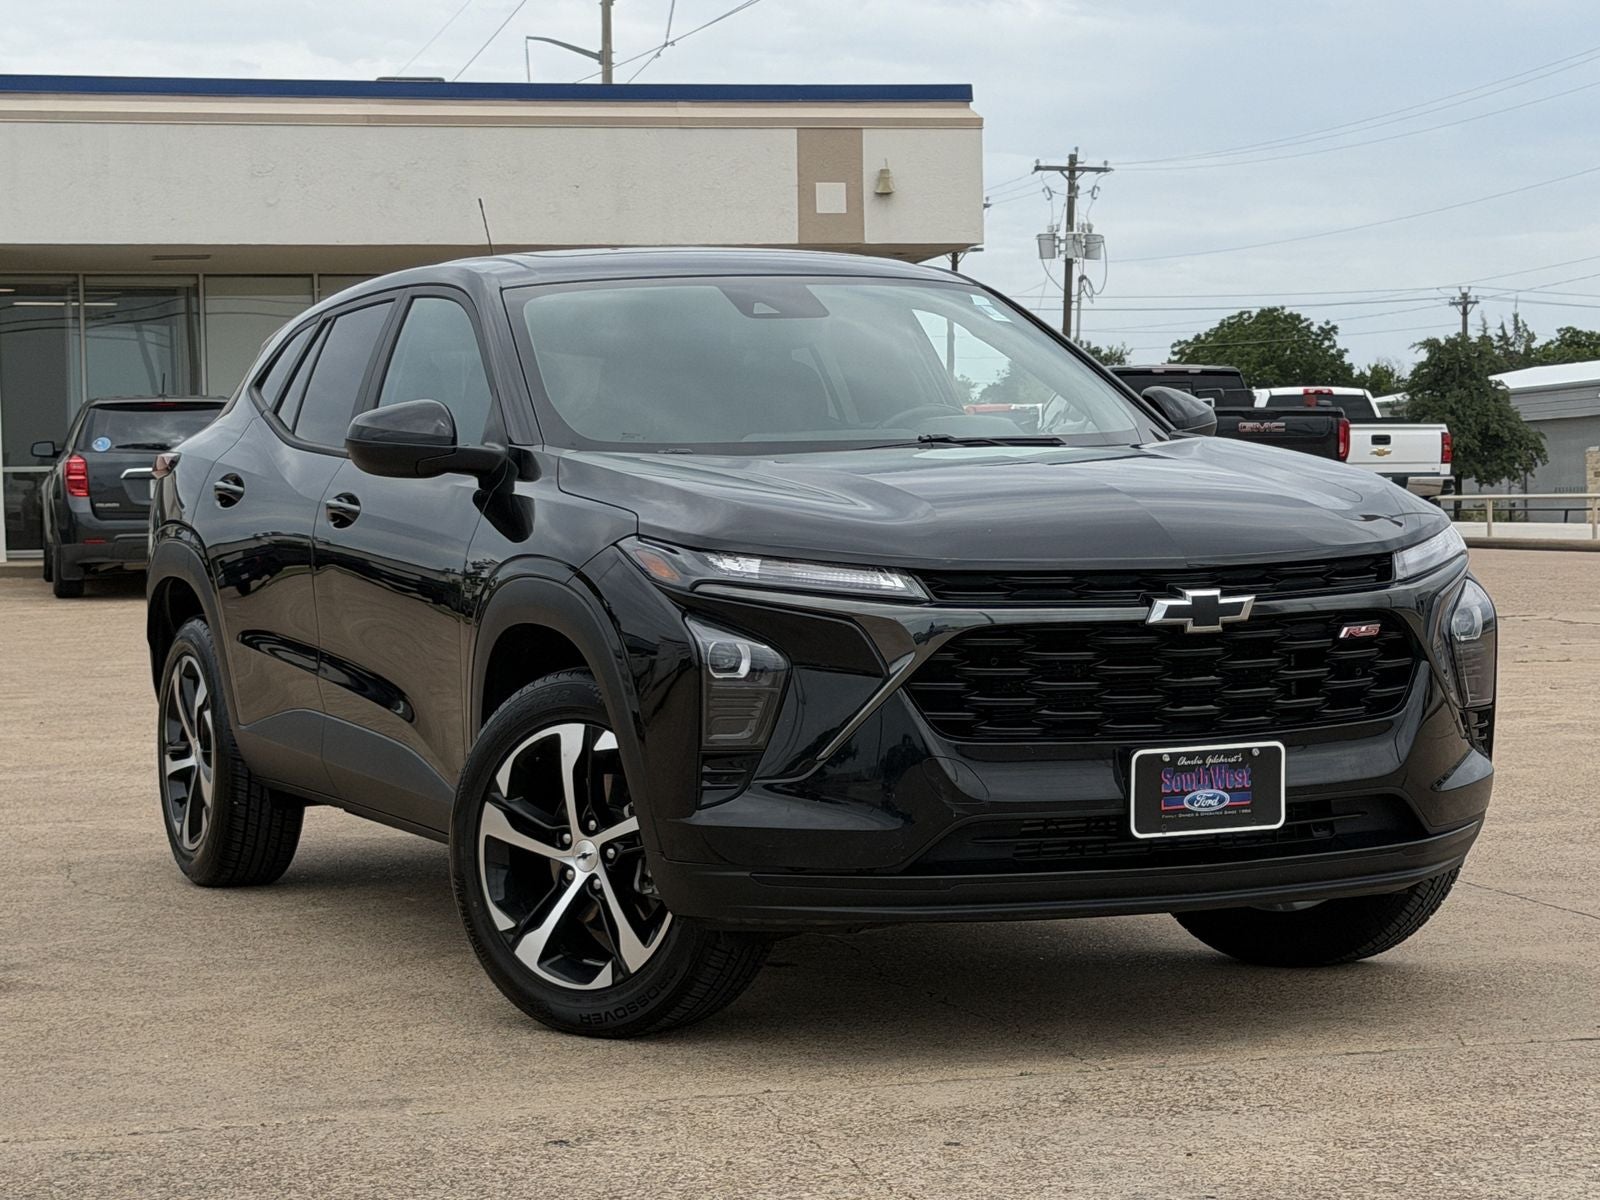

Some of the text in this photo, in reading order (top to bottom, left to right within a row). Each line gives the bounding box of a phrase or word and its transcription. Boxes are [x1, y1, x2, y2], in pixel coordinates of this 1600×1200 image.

[1238, 422, 1286, 432] GMC
[1339, 624, 1381, 638] RS
[1194, 794, 1220, 807] Ford
